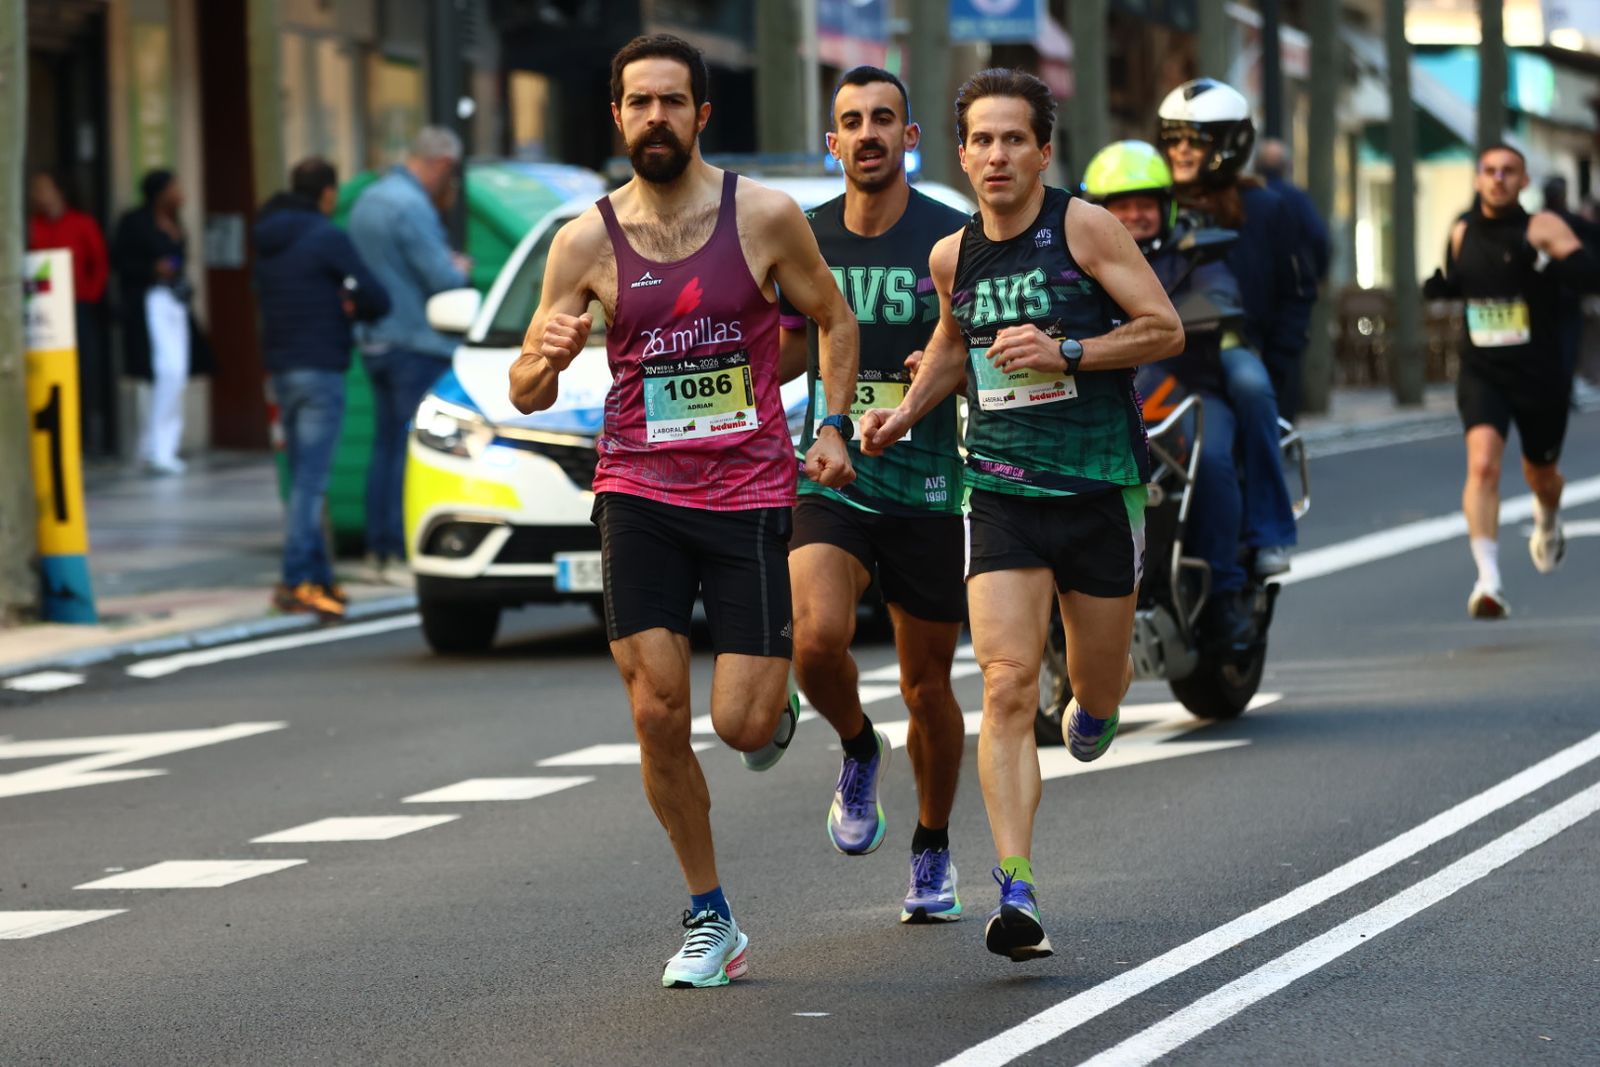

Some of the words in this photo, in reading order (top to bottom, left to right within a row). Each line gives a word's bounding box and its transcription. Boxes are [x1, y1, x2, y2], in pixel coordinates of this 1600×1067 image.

[1035, 229, 1052, 239] AVS
[971, 267, 1052, 328] AVS
[641, 328, 665, 358] 26
[672, 316, 742, 352] millas
[699, 359, 719, 368] 2026
[863, 369, 882, 378] 2026
[1008, 373, 1029, 381] JORGE
[664, 373, 732, 401] 1086
[687, 402, 714, 411] ADRIAN
[653, 426, 682, 434] LABORAL
[34, 384, 68, 522] 1
[925, 476, 946, 489] AVS
[925, 491, 947, 502] 1990
